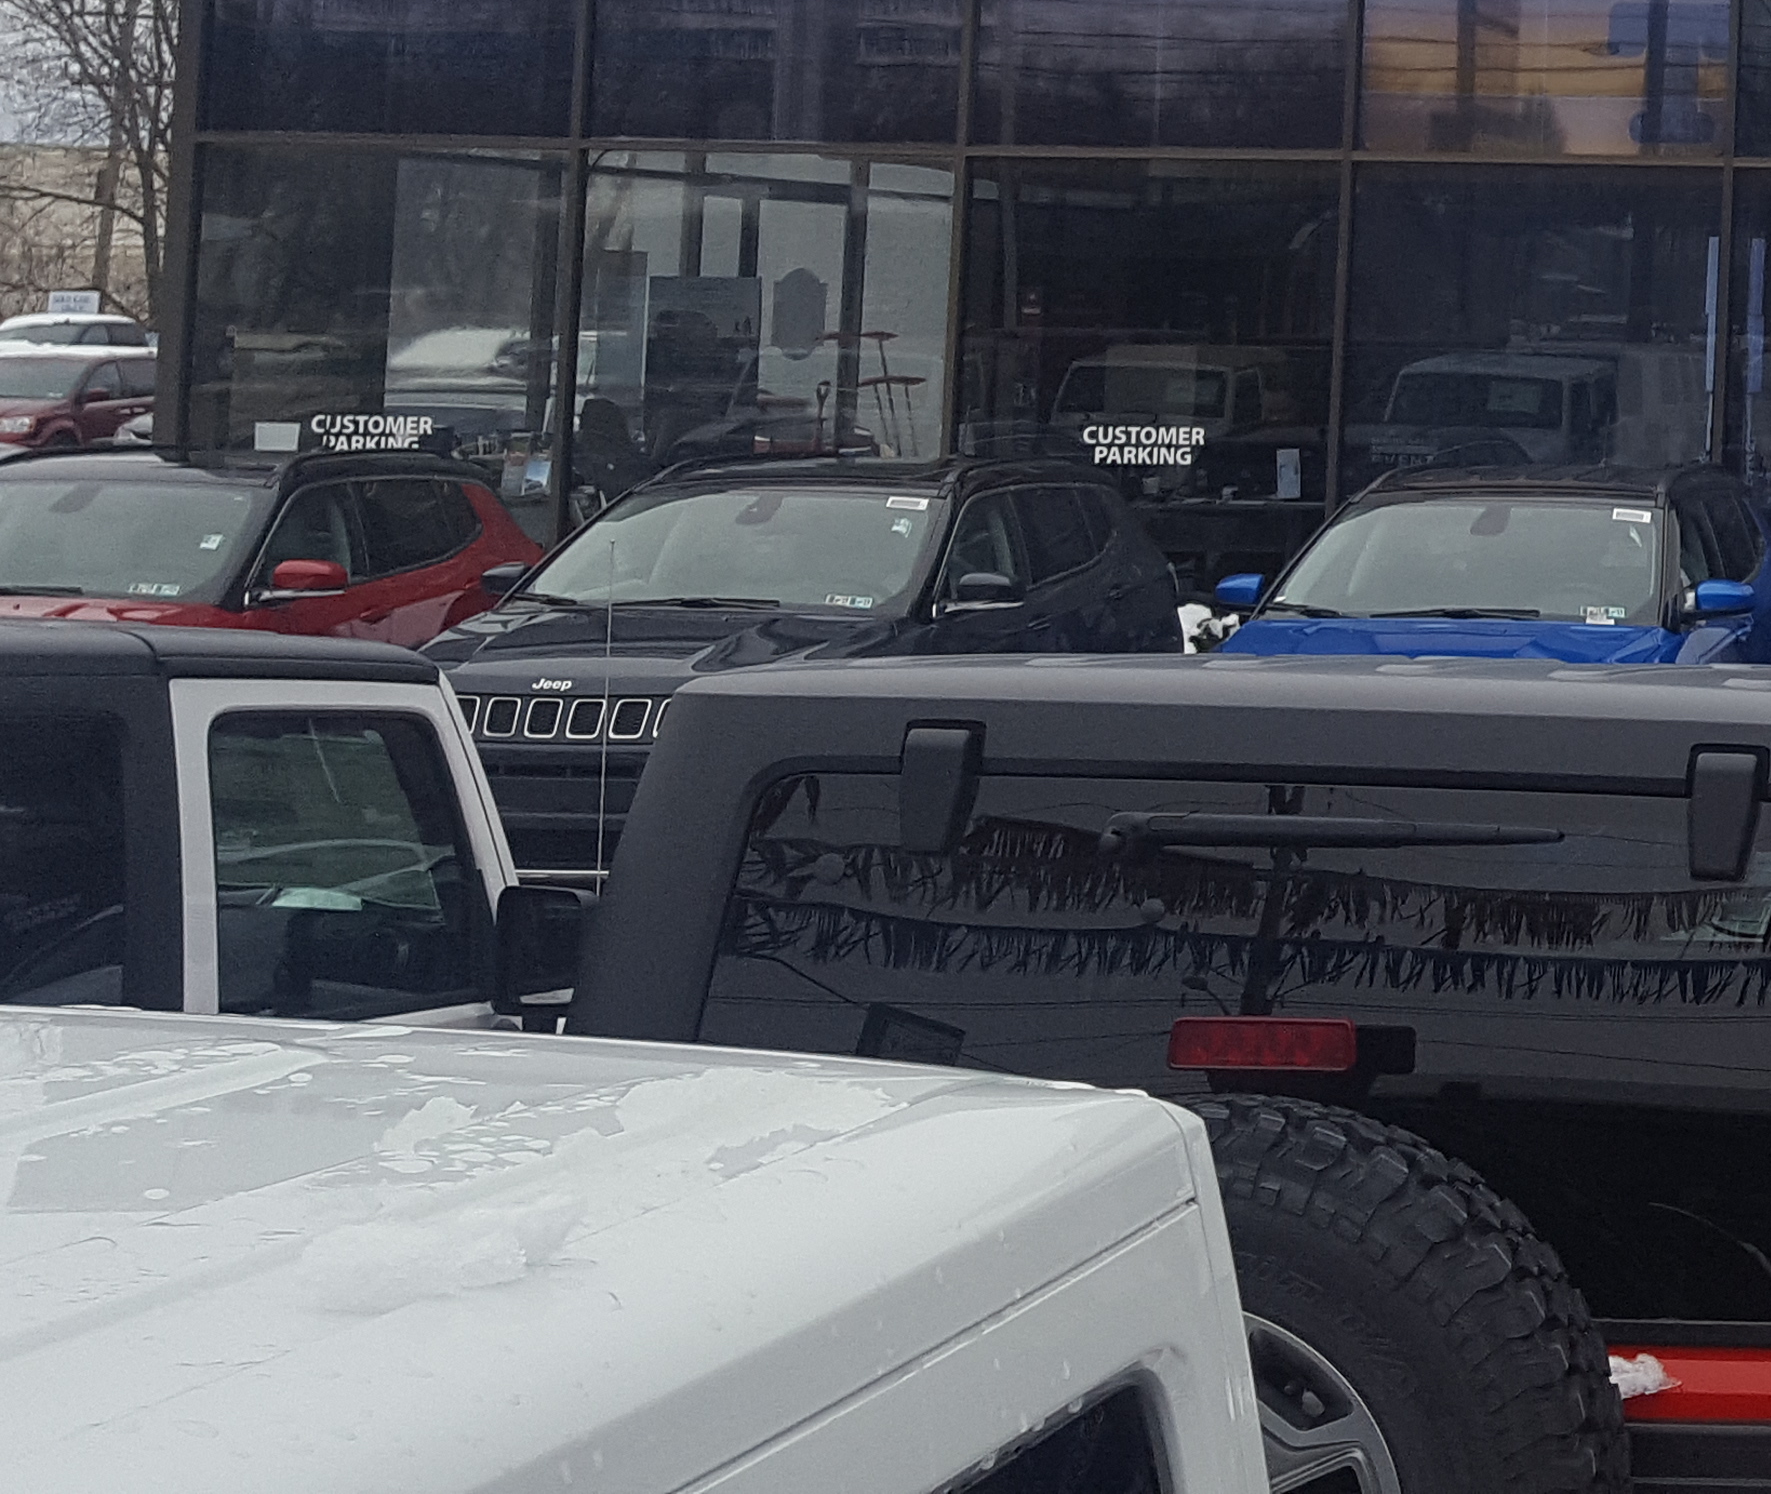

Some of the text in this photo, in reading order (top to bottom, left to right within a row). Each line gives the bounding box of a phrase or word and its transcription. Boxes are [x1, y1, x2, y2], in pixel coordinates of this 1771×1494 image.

[311, 414, 433, 435] CUSTOMER
[1082, 425, 1205, 446] CUSTOMER
[1094, 446, 1192, 466] PARKING
[531, 678, 572, 692] Jeep
